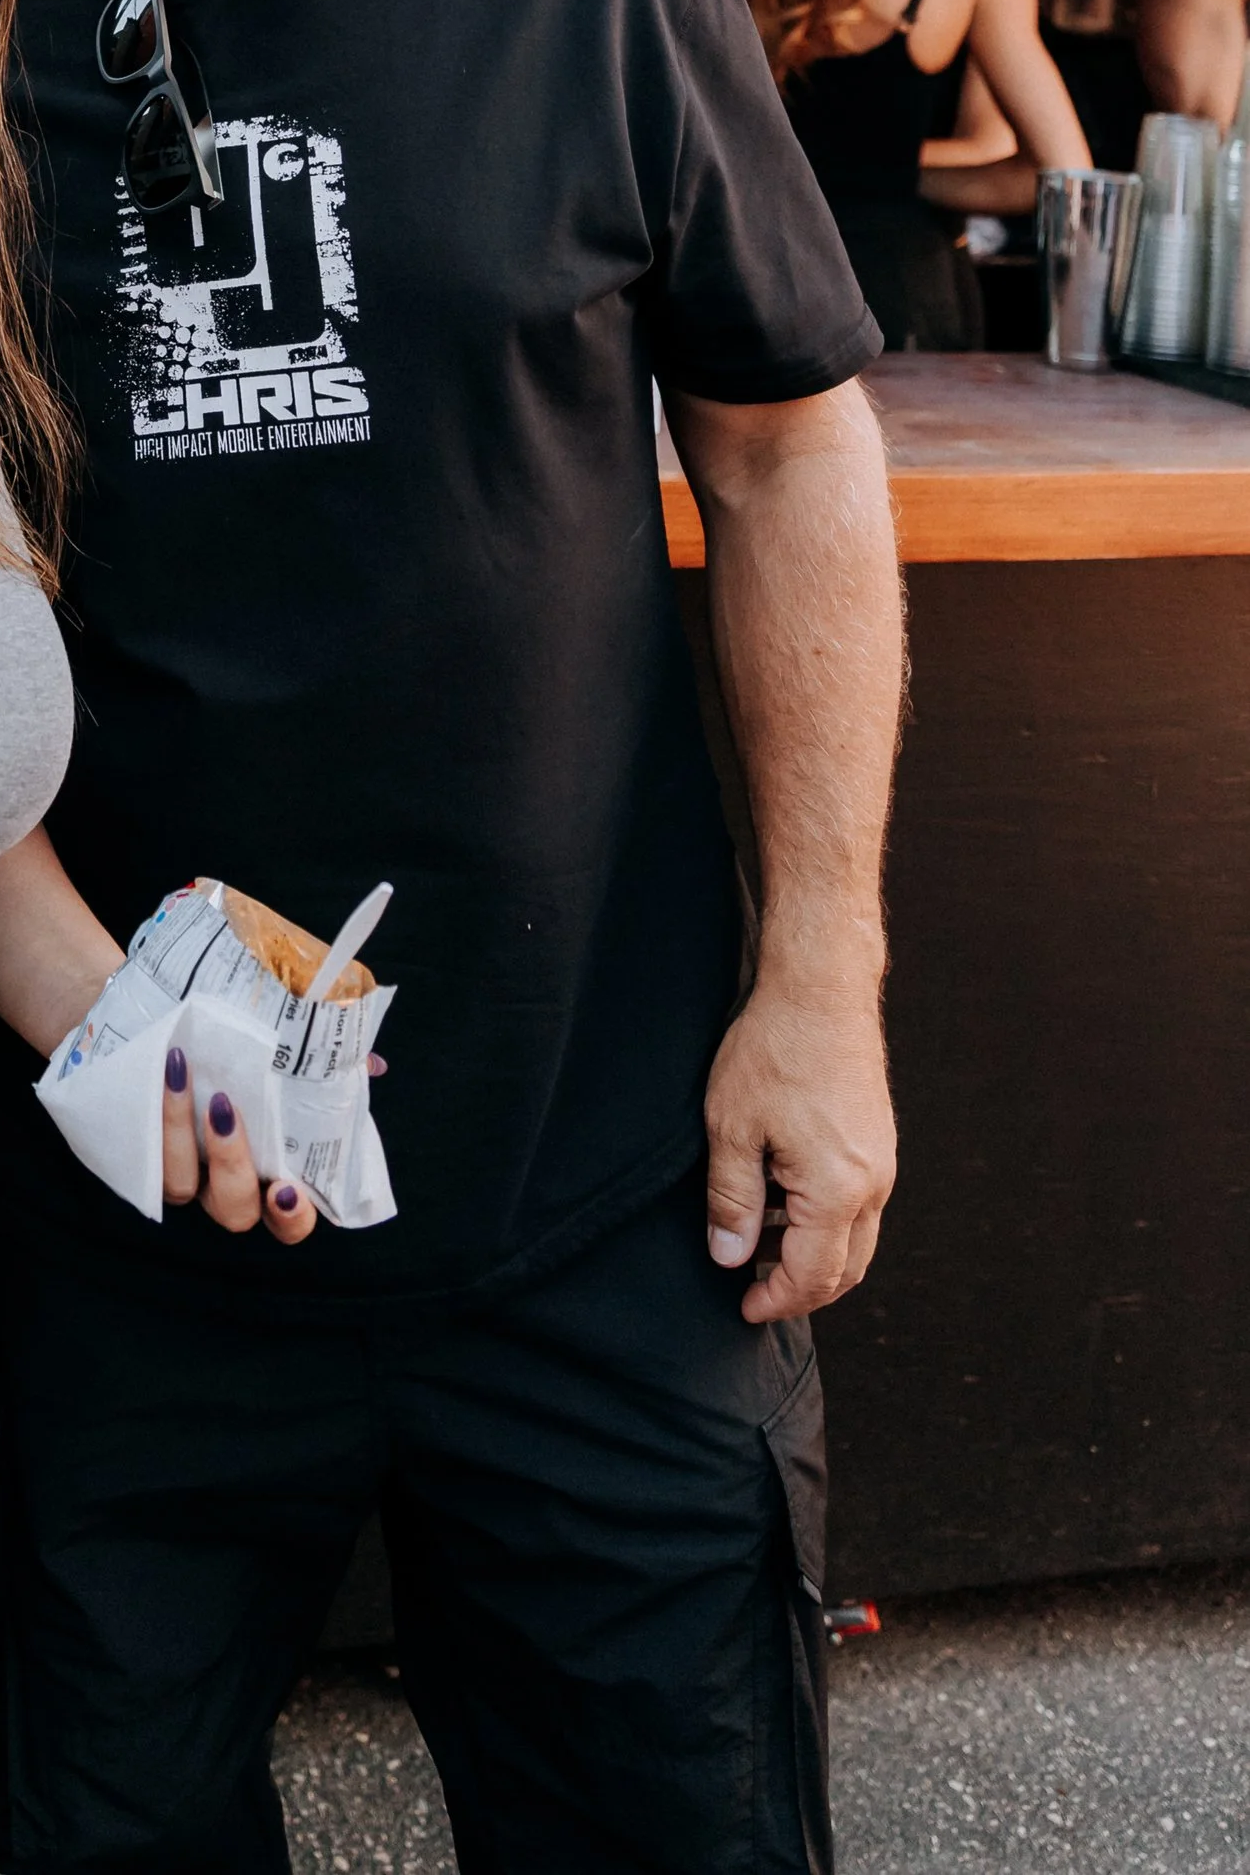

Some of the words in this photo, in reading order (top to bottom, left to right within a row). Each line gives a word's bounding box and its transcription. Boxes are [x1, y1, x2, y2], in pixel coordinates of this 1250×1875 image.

[132, 366, 370, 436] CHRIS
[135, 438, 164, 461] HIGH
[168, 432, 213, 459] IMPACT
[217, 426, 264, 454] MOBILE
[268, 416, 371, 450] ENTERTAINMENT
[272, 1043, 292, 1070] 160
